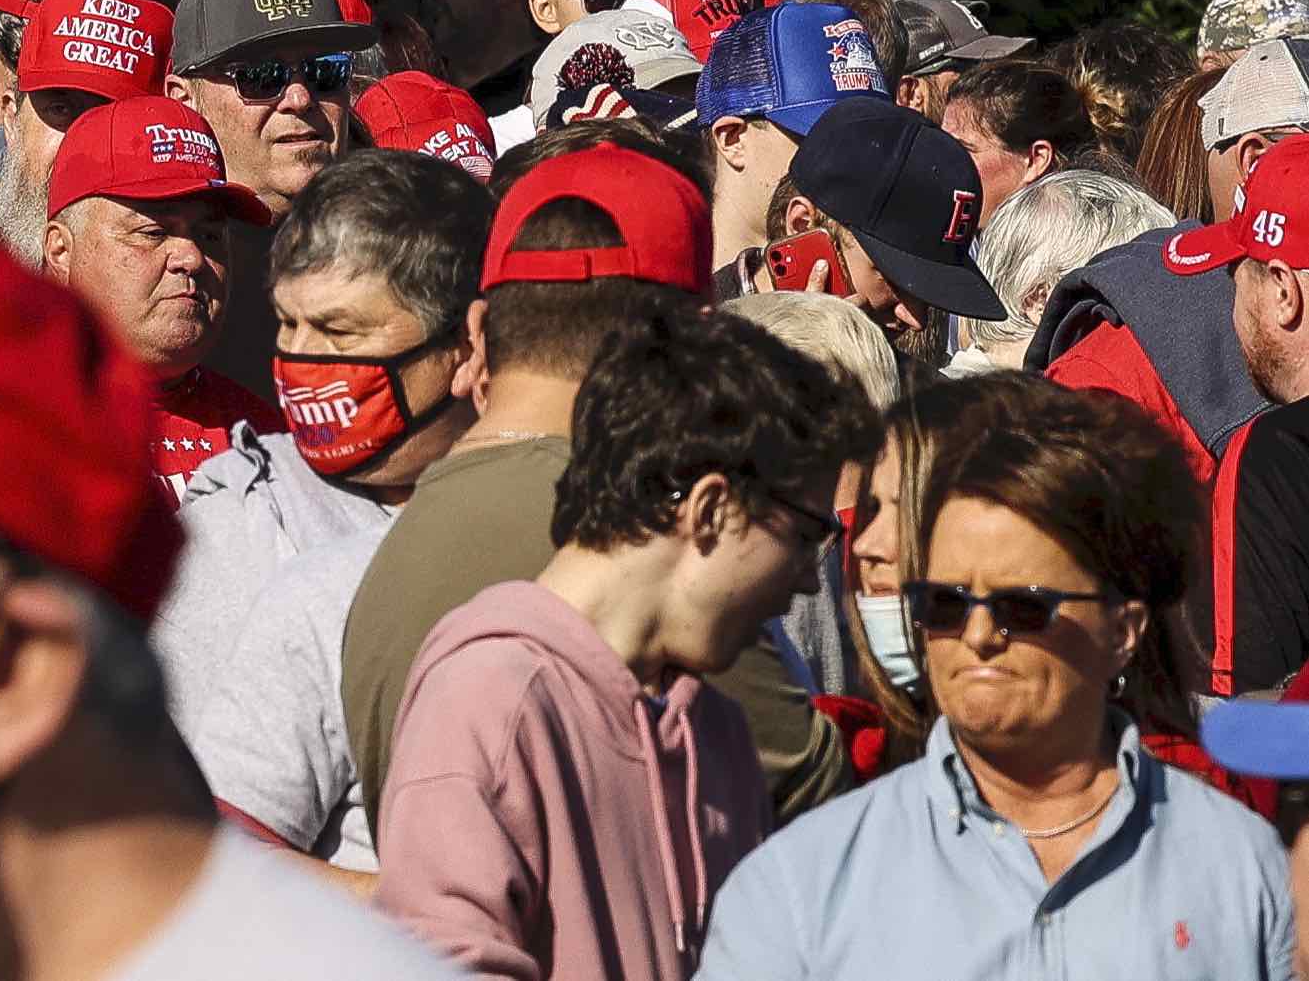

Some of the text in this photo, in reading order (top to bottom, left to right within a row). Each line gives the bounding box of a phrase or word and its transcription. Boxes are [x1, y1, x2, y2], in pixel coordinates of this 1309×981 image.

[53, 16, 155, 56] AMERICA
[63, 40, 139, 74] GREAT
[832, 73, 870, 92] TRUMP
[145, 124, 218, 155] Trump
[1252, 210, 1286, 247] 45
